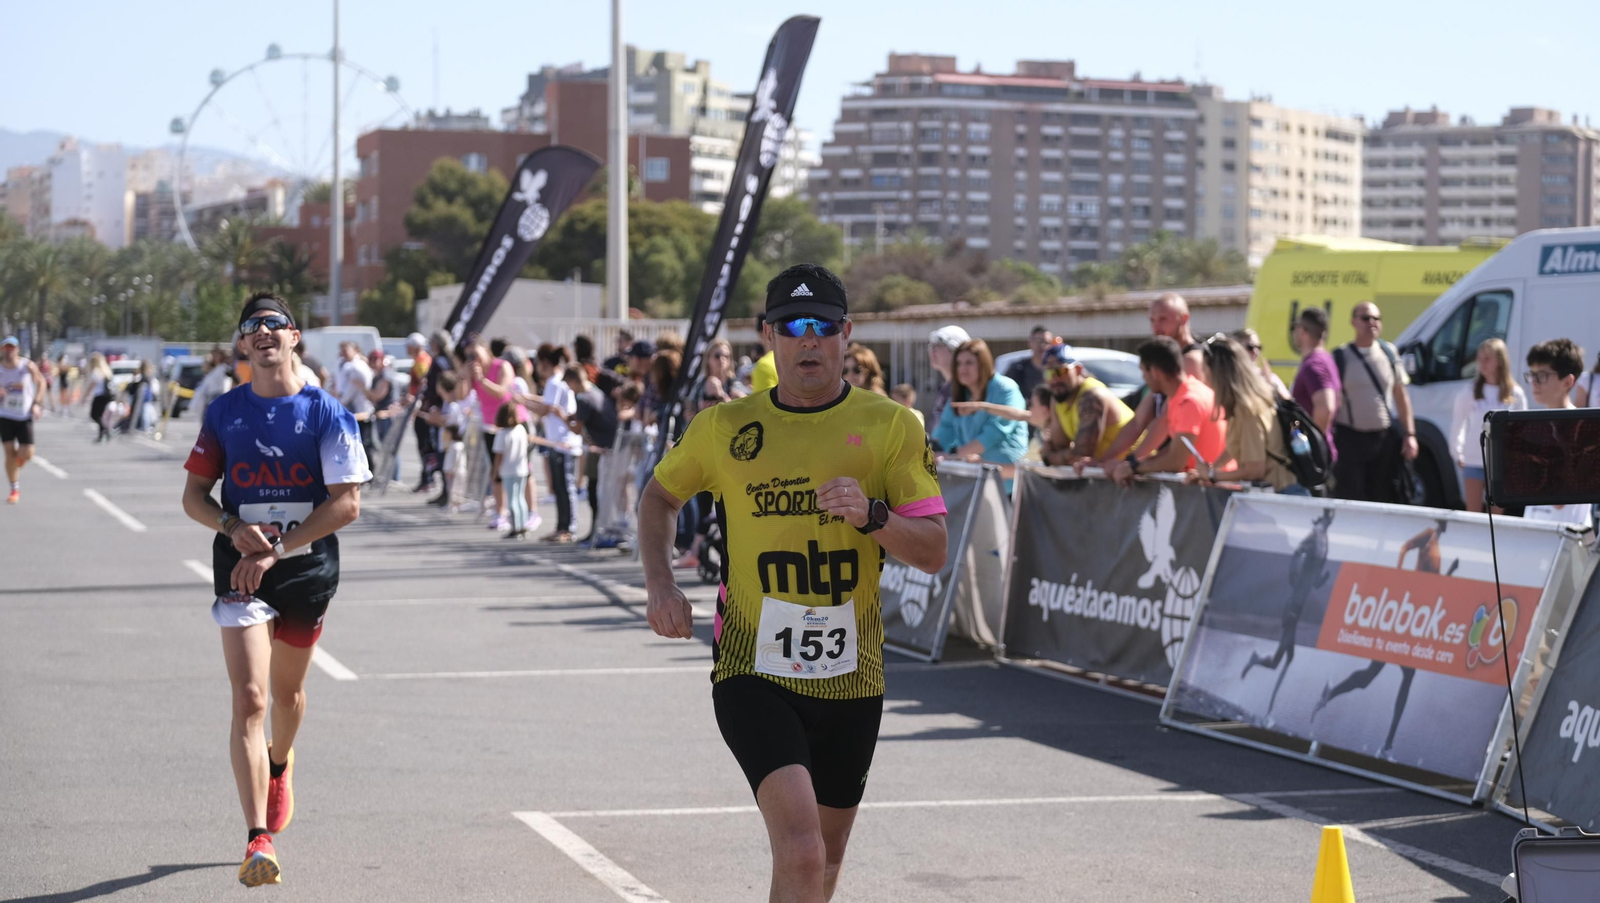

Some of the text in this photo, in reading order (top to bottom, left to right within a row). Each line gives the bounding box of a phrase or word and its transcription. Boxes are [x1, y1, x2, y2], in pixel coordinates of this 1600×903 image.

[1291, 270, 1339, 286] SOPORTE
[1341, 270, 1370, 286] VITAL
[790, 290, 814, 298] adidas
[258, 488, 292, 497] SPORT
[746, 476, 811, 496] Centro Deportivo
[819, 513, 829, 526] El
[757, 539, 859, 606] mtp
[1028, 572, 1163, 632] aquéatacamos
[1343, 582, 1467, 645] balabak.es
[775, 627, 847, 662] 153
[1337, 627, 1454, 664] Diseñamos tu evento desde cero
